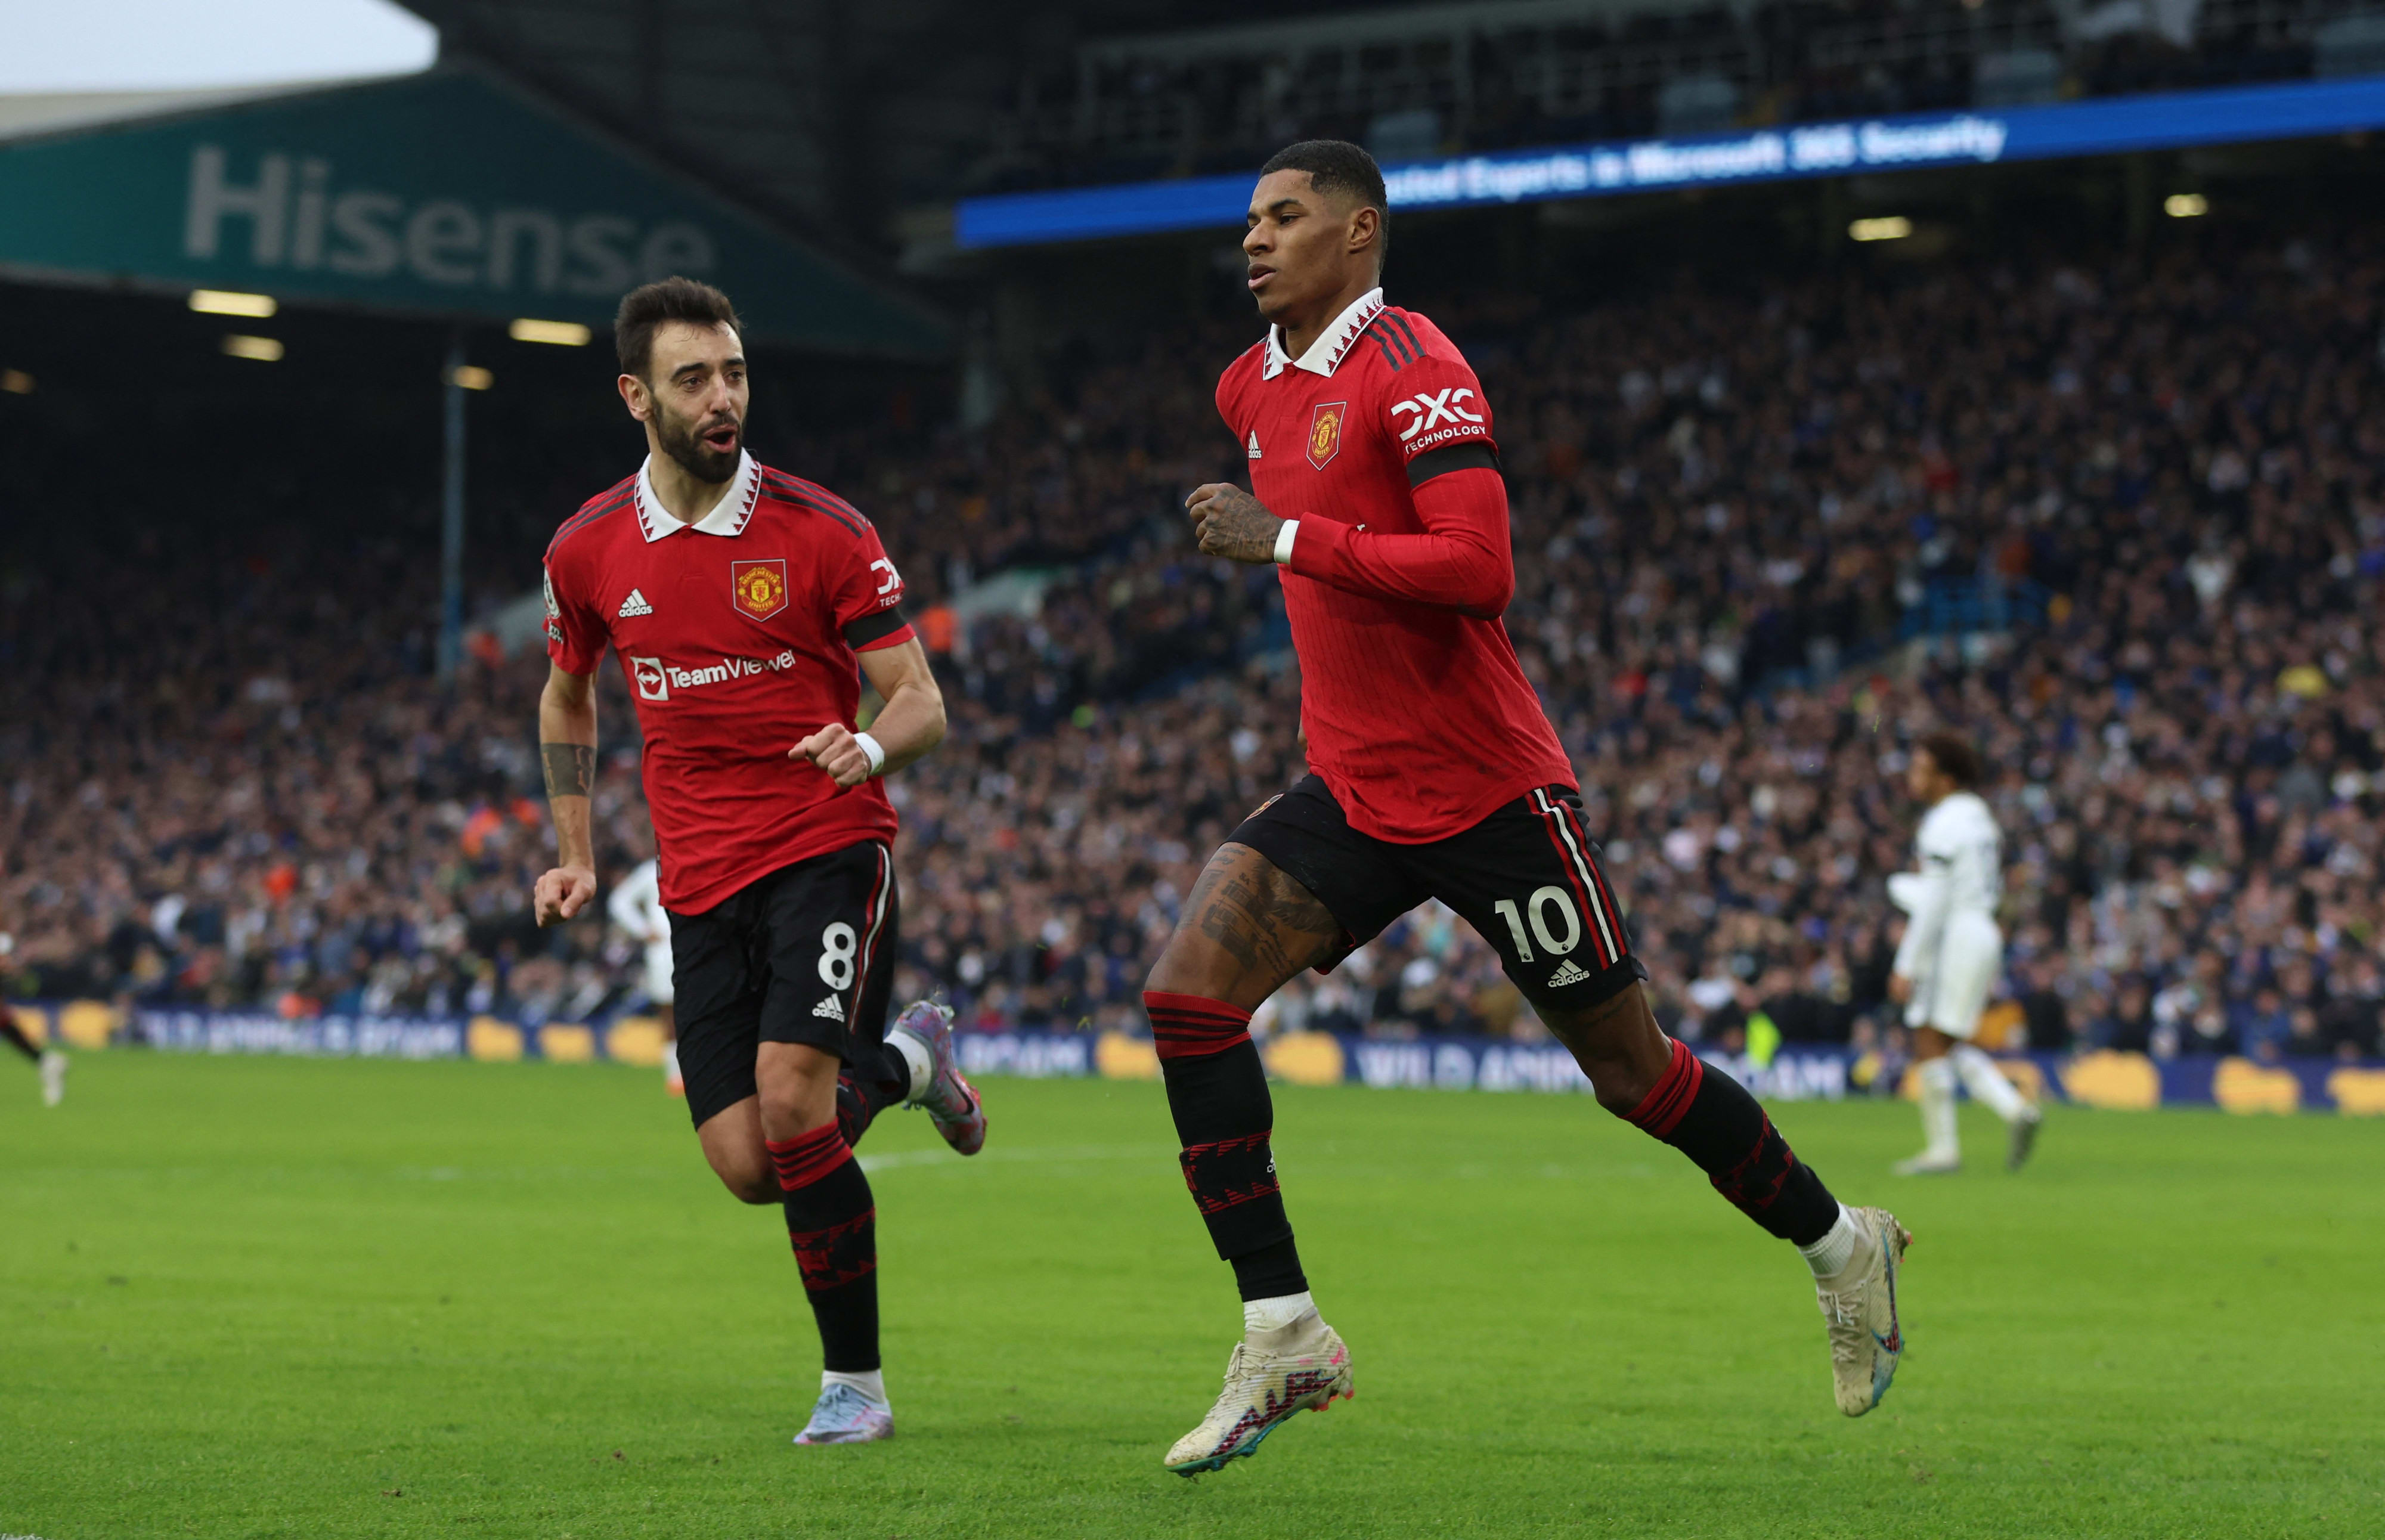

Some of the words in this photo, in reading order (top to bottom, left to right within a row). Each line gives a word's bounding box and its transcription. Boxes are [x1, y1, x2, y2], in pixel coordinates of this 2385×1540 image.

[1628, 132, 1786, 183] Microsoft
[1860, 114, 2005, 163] Security
[185, 145, 711, 295] Hisense
[1390, 388, 1483, 441] DXC
[1314, 446, 1329, 455] UNITED
[1405, 426, 1486, 454] TECHNOLOGY
[742, 570, 778, 585] MANCHESTER
[871, 556, 902, 594] DX
[618, 605, 653, 617] adidas
[749, 600, 773, 608] UNITED
[879, 593, 901, 607] TECH
[1495, 885, 1580, 962] 10
[817, 921, 856, 990] 8
[1548, 970, 1590, 987] adidas
